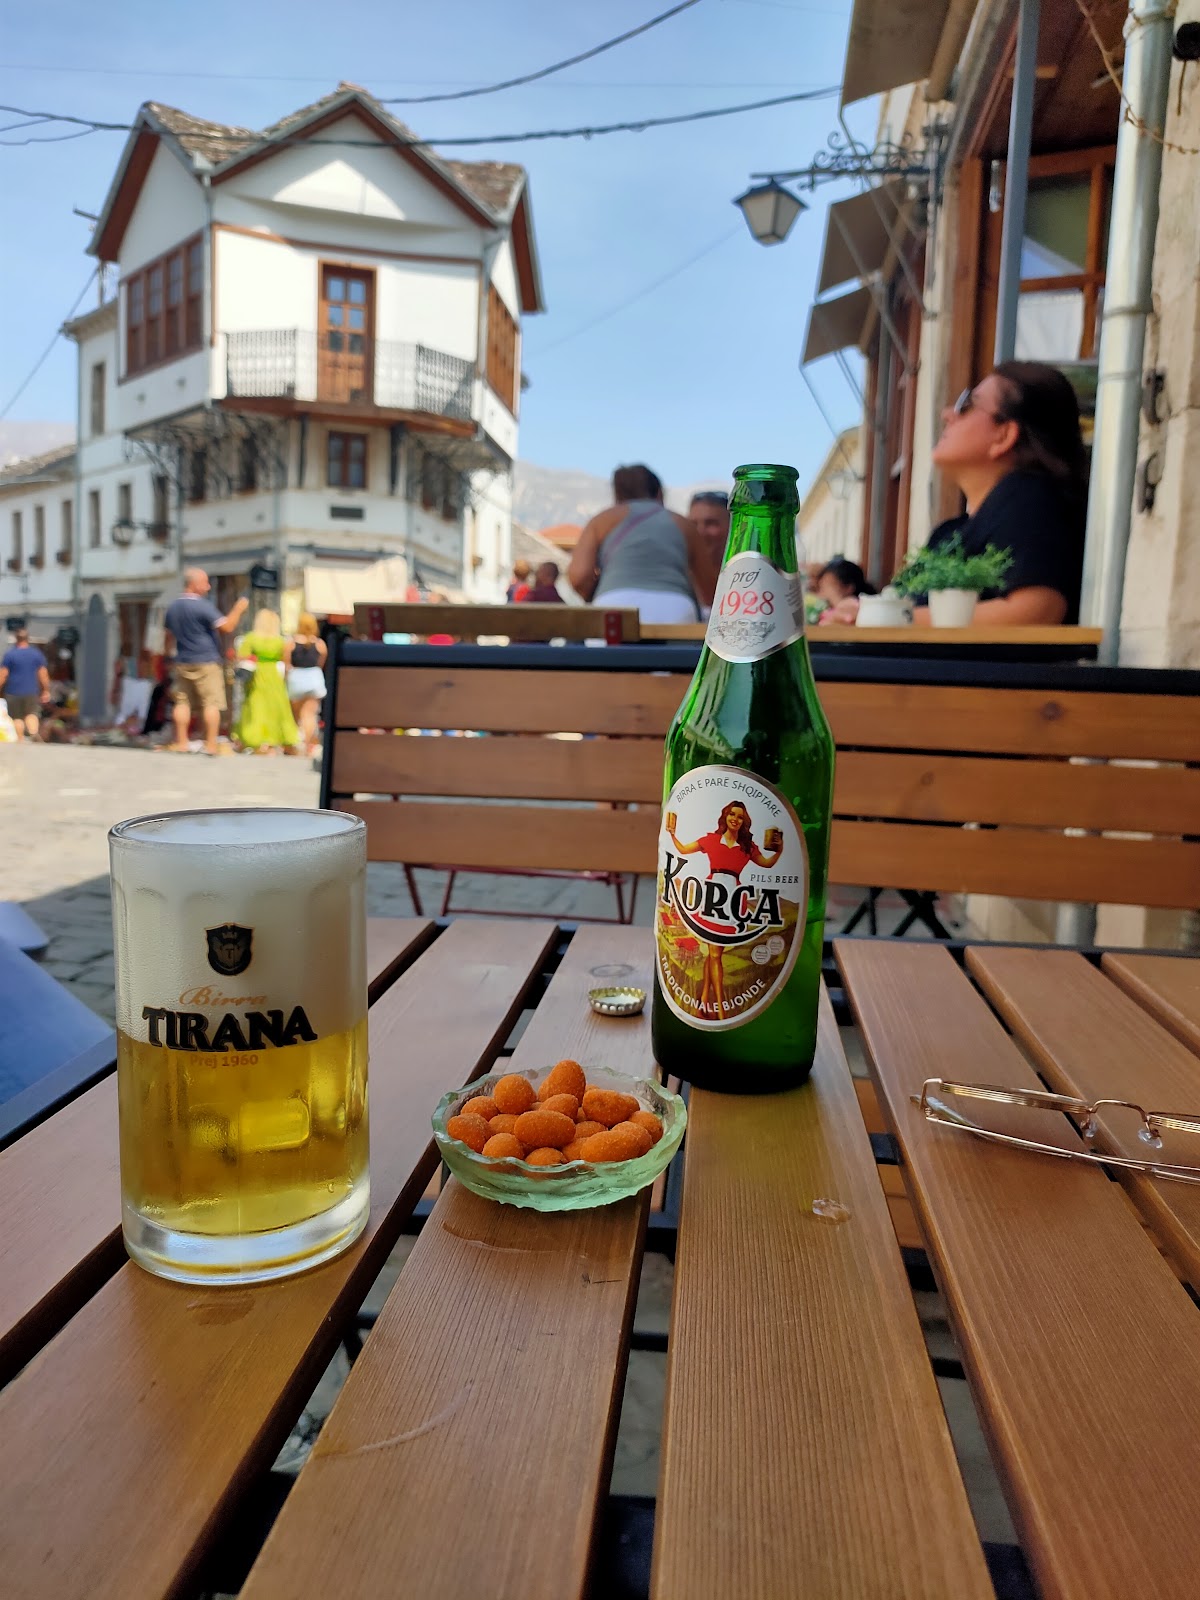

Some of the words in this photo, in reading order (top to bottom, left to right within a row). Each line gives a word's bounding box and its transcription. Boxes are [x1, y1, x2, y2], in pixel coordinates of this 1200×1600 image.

[729, 568, 762, 589] prej
[719, 590, 775, 616] 1928
[676, 783, 697, 803] BIRRA
[697, 780, 703, 789] E
[704, 777, 730, 788] PARË
[731, 780, 782, 818] SHQIPTARE
[662, 851, 784, 934] KORÇA
[750, 873, 773, 884] PILS
[775, 874, 800, 884] BEER
[661, 955, 720, 1013] TRADICIONALE
[722, 978, 766, 1012] BJONDE
[142, 1005, 318, 1053] TIRANA
